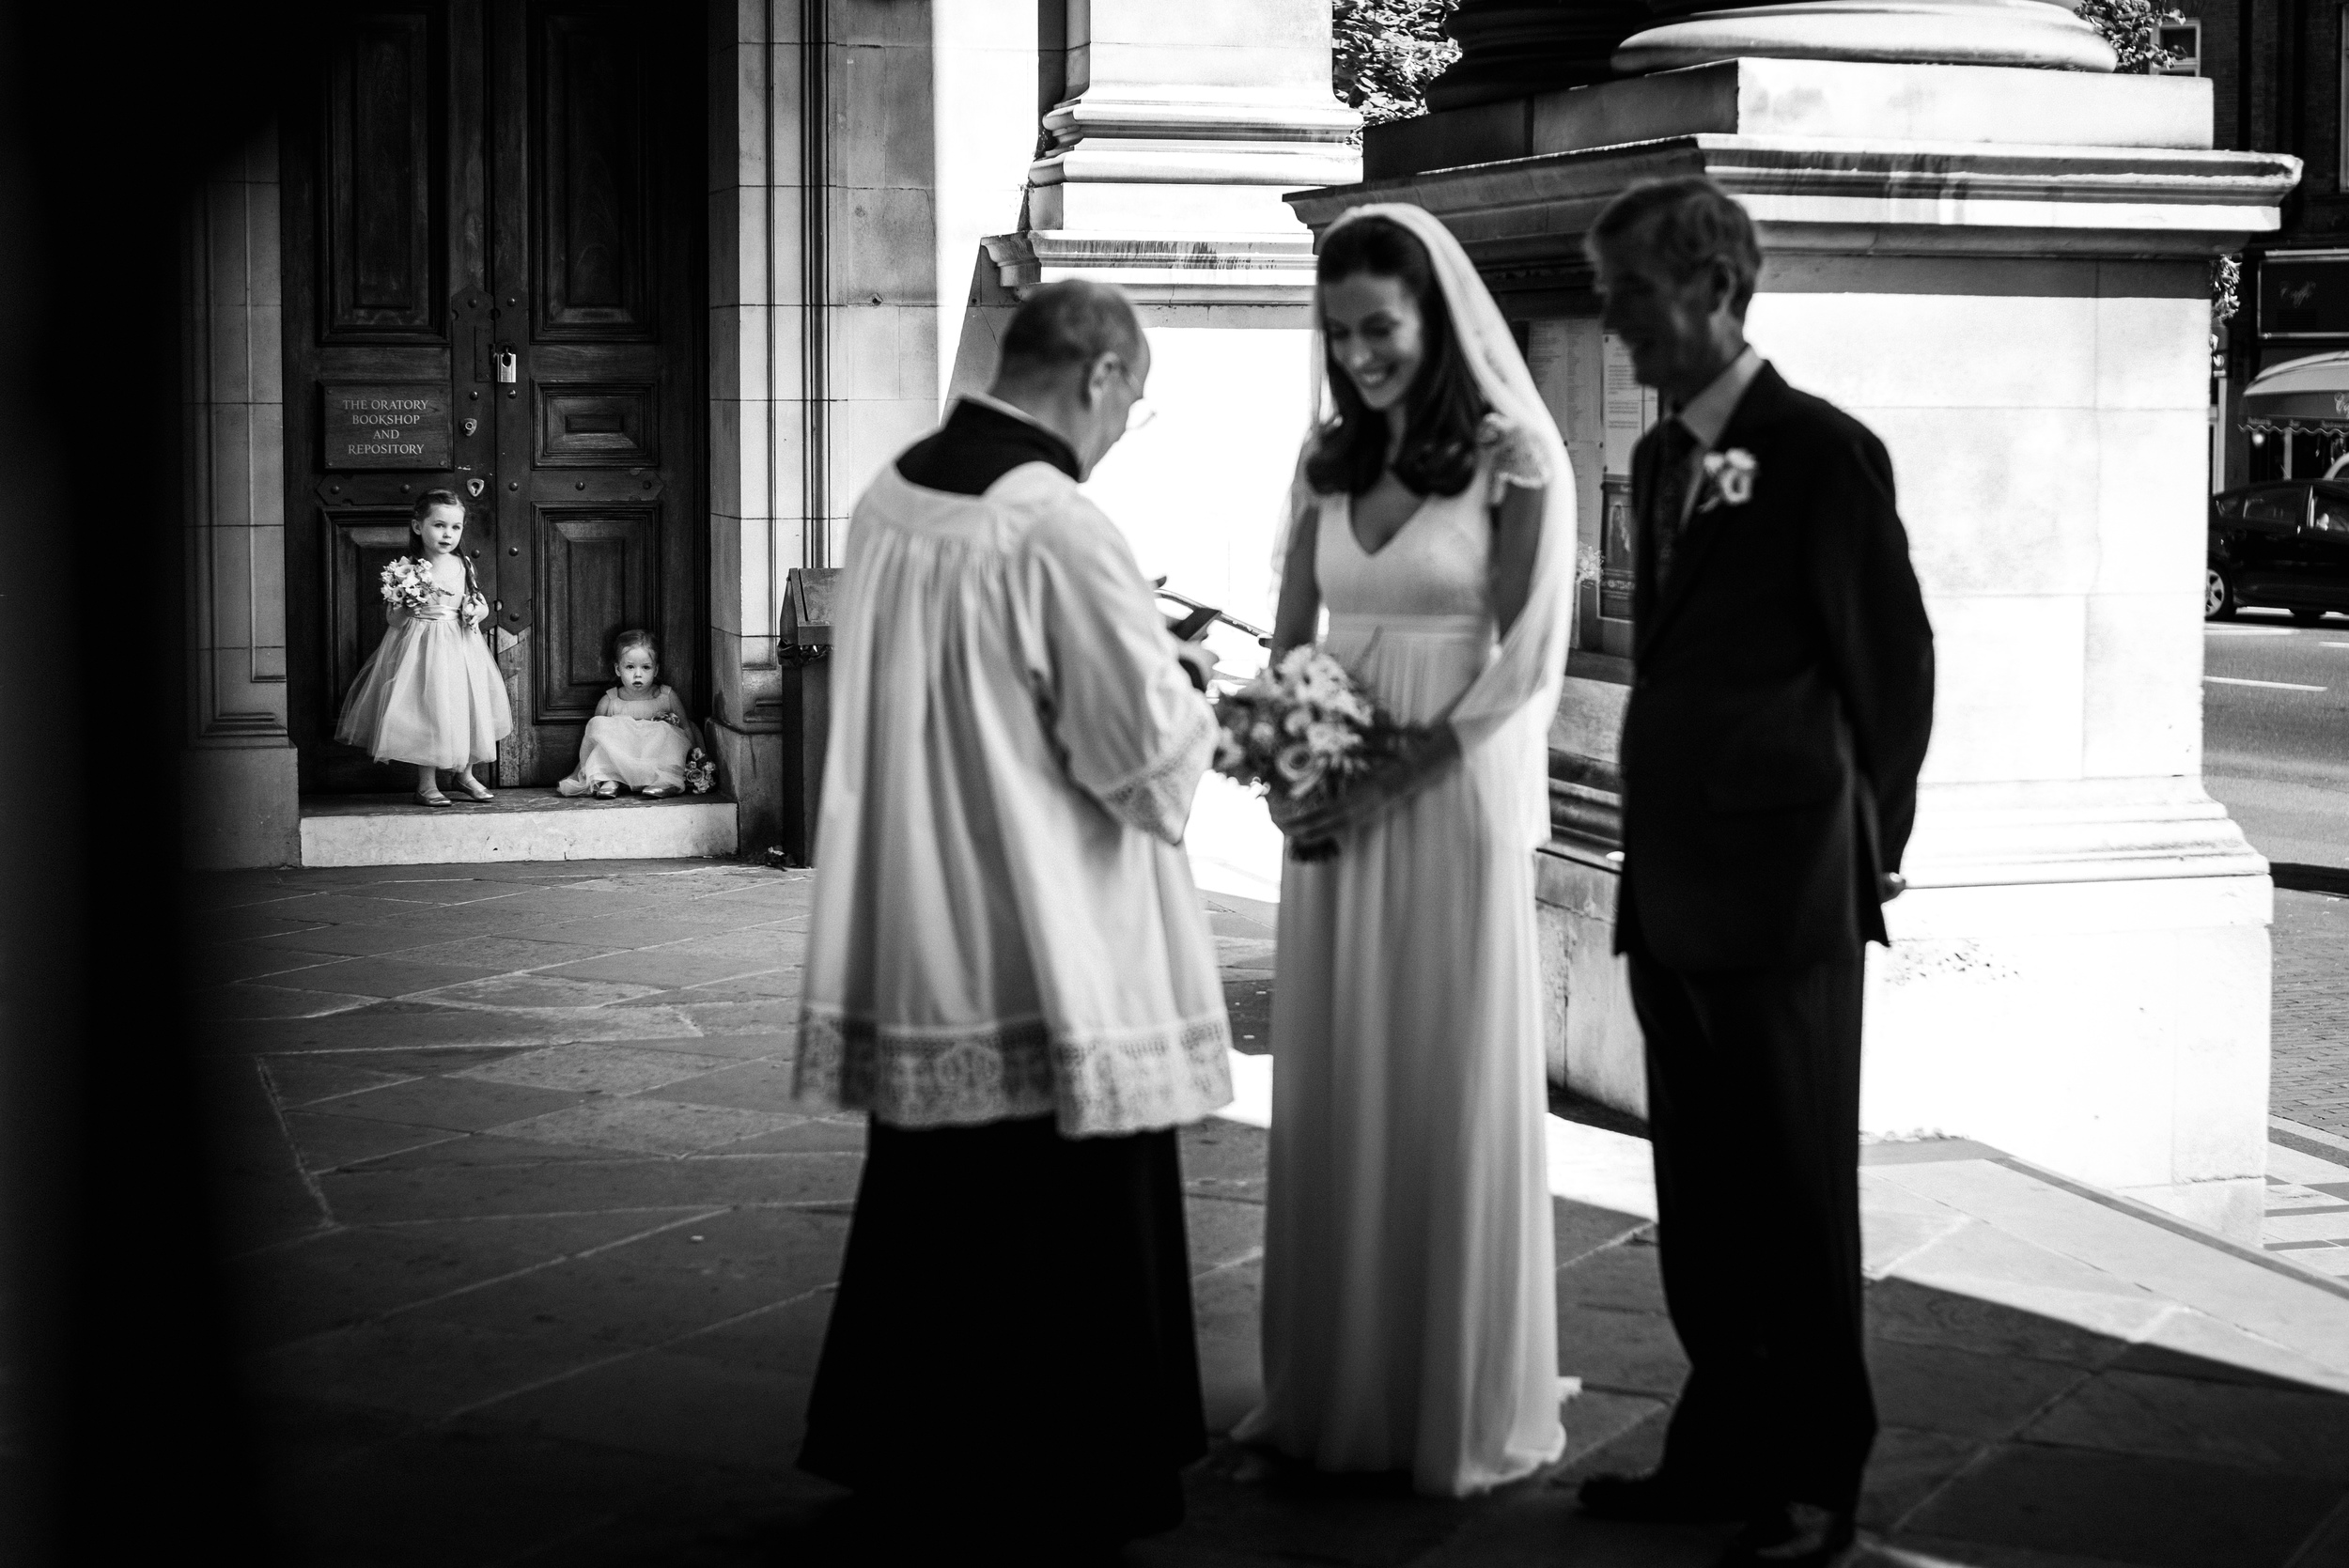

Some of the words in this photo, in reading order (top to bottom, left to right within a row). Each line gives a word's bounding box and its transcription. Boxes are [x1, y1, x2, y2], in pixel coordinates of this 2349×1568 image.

[342, 399, 367, 410] THE
[371, 399, 428, 411] ORATORY
[352, 414, 420, 426] BOOKSHOP
[373, 429, 399, 440] AND
[348, 443, 425, 455] REPOSITORY
